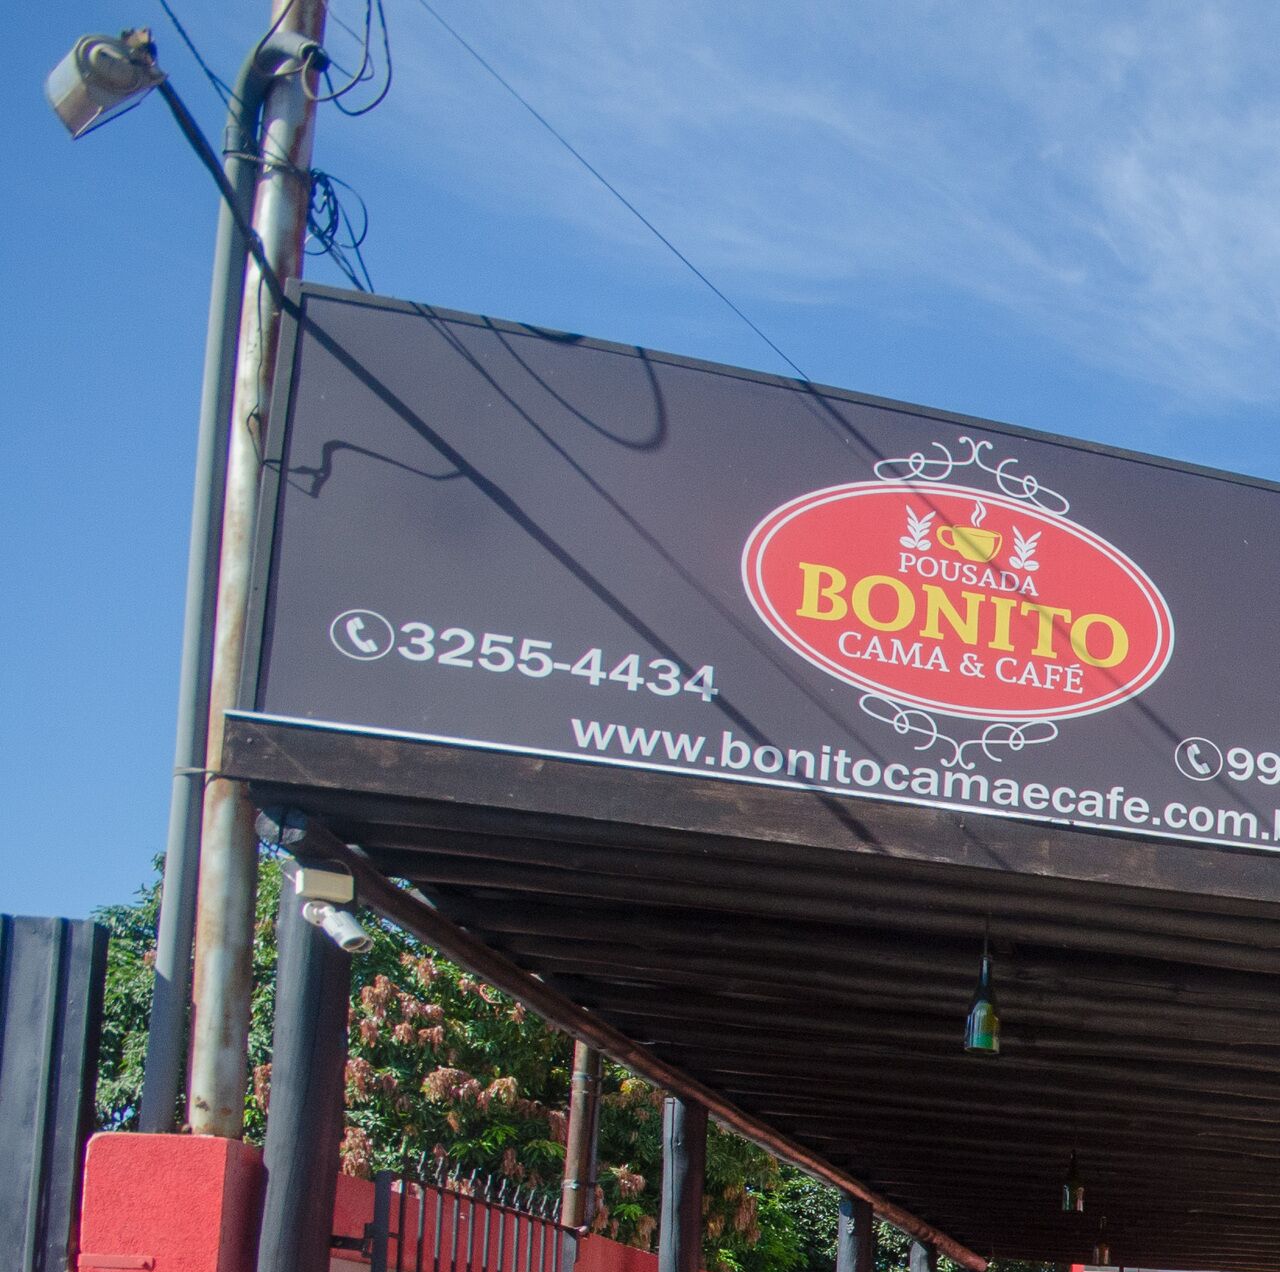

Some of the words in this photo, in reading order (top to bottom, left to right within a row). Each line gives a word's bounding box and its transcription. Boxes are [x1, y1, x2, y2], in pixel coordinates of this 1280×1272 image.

[898, 552, 1039, 597] POUSADA
[796, 561, 1129, 668] BONITO
[397, 621, 719, 703] 3255-4434
[838, 631, 949, 672] CAMA
[959, 652, 985, 678] &
[995, 657, 1084, 694] CAFÉ
